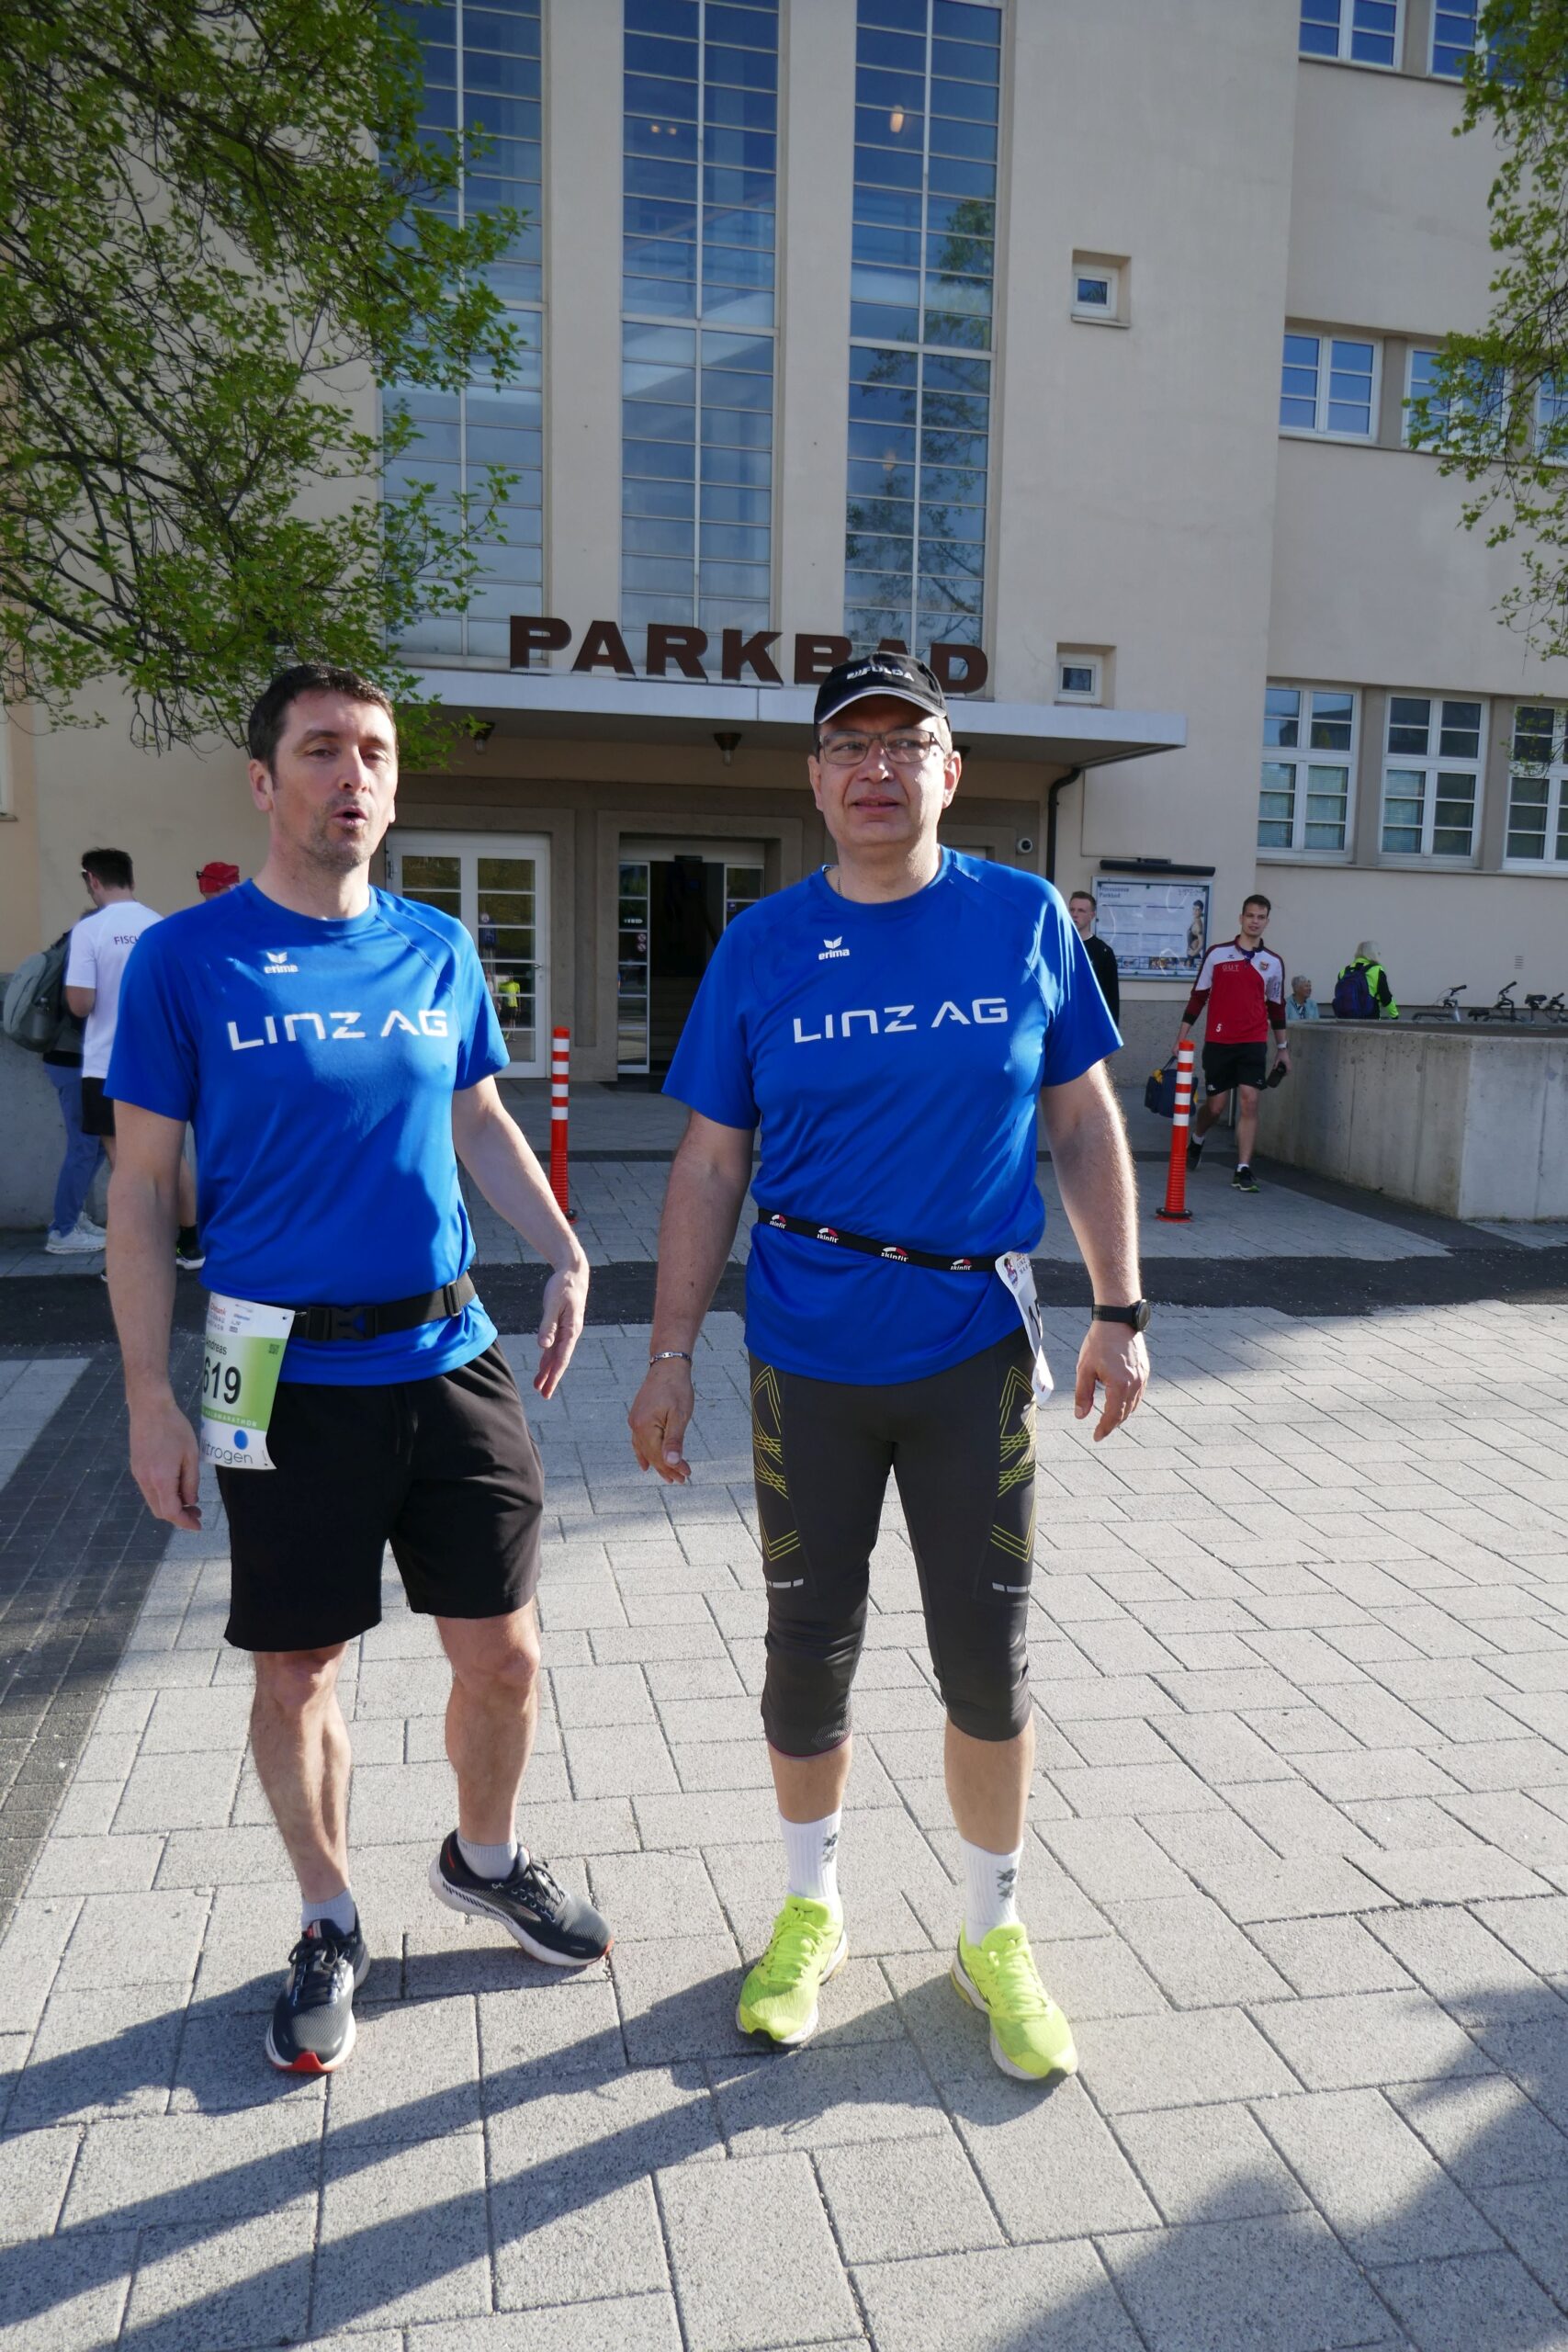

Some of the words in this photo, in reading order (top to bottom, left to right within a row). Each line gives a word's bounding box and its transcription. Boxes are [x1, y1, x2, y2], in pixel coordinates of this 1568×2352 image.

[818, 948, 850, 960] erima
[264, 964, 299, 974] erima
[931, 998, 1009, 1028] AG
[380, 1010, 448, 1037] AG
[1215, 1023, 1223, 1033] 5
[769, 1220, 786, 1229] skinfit
[817, 1233, 839, 1244] skinfit
[880, 1251, 908, 1262] skinfit
